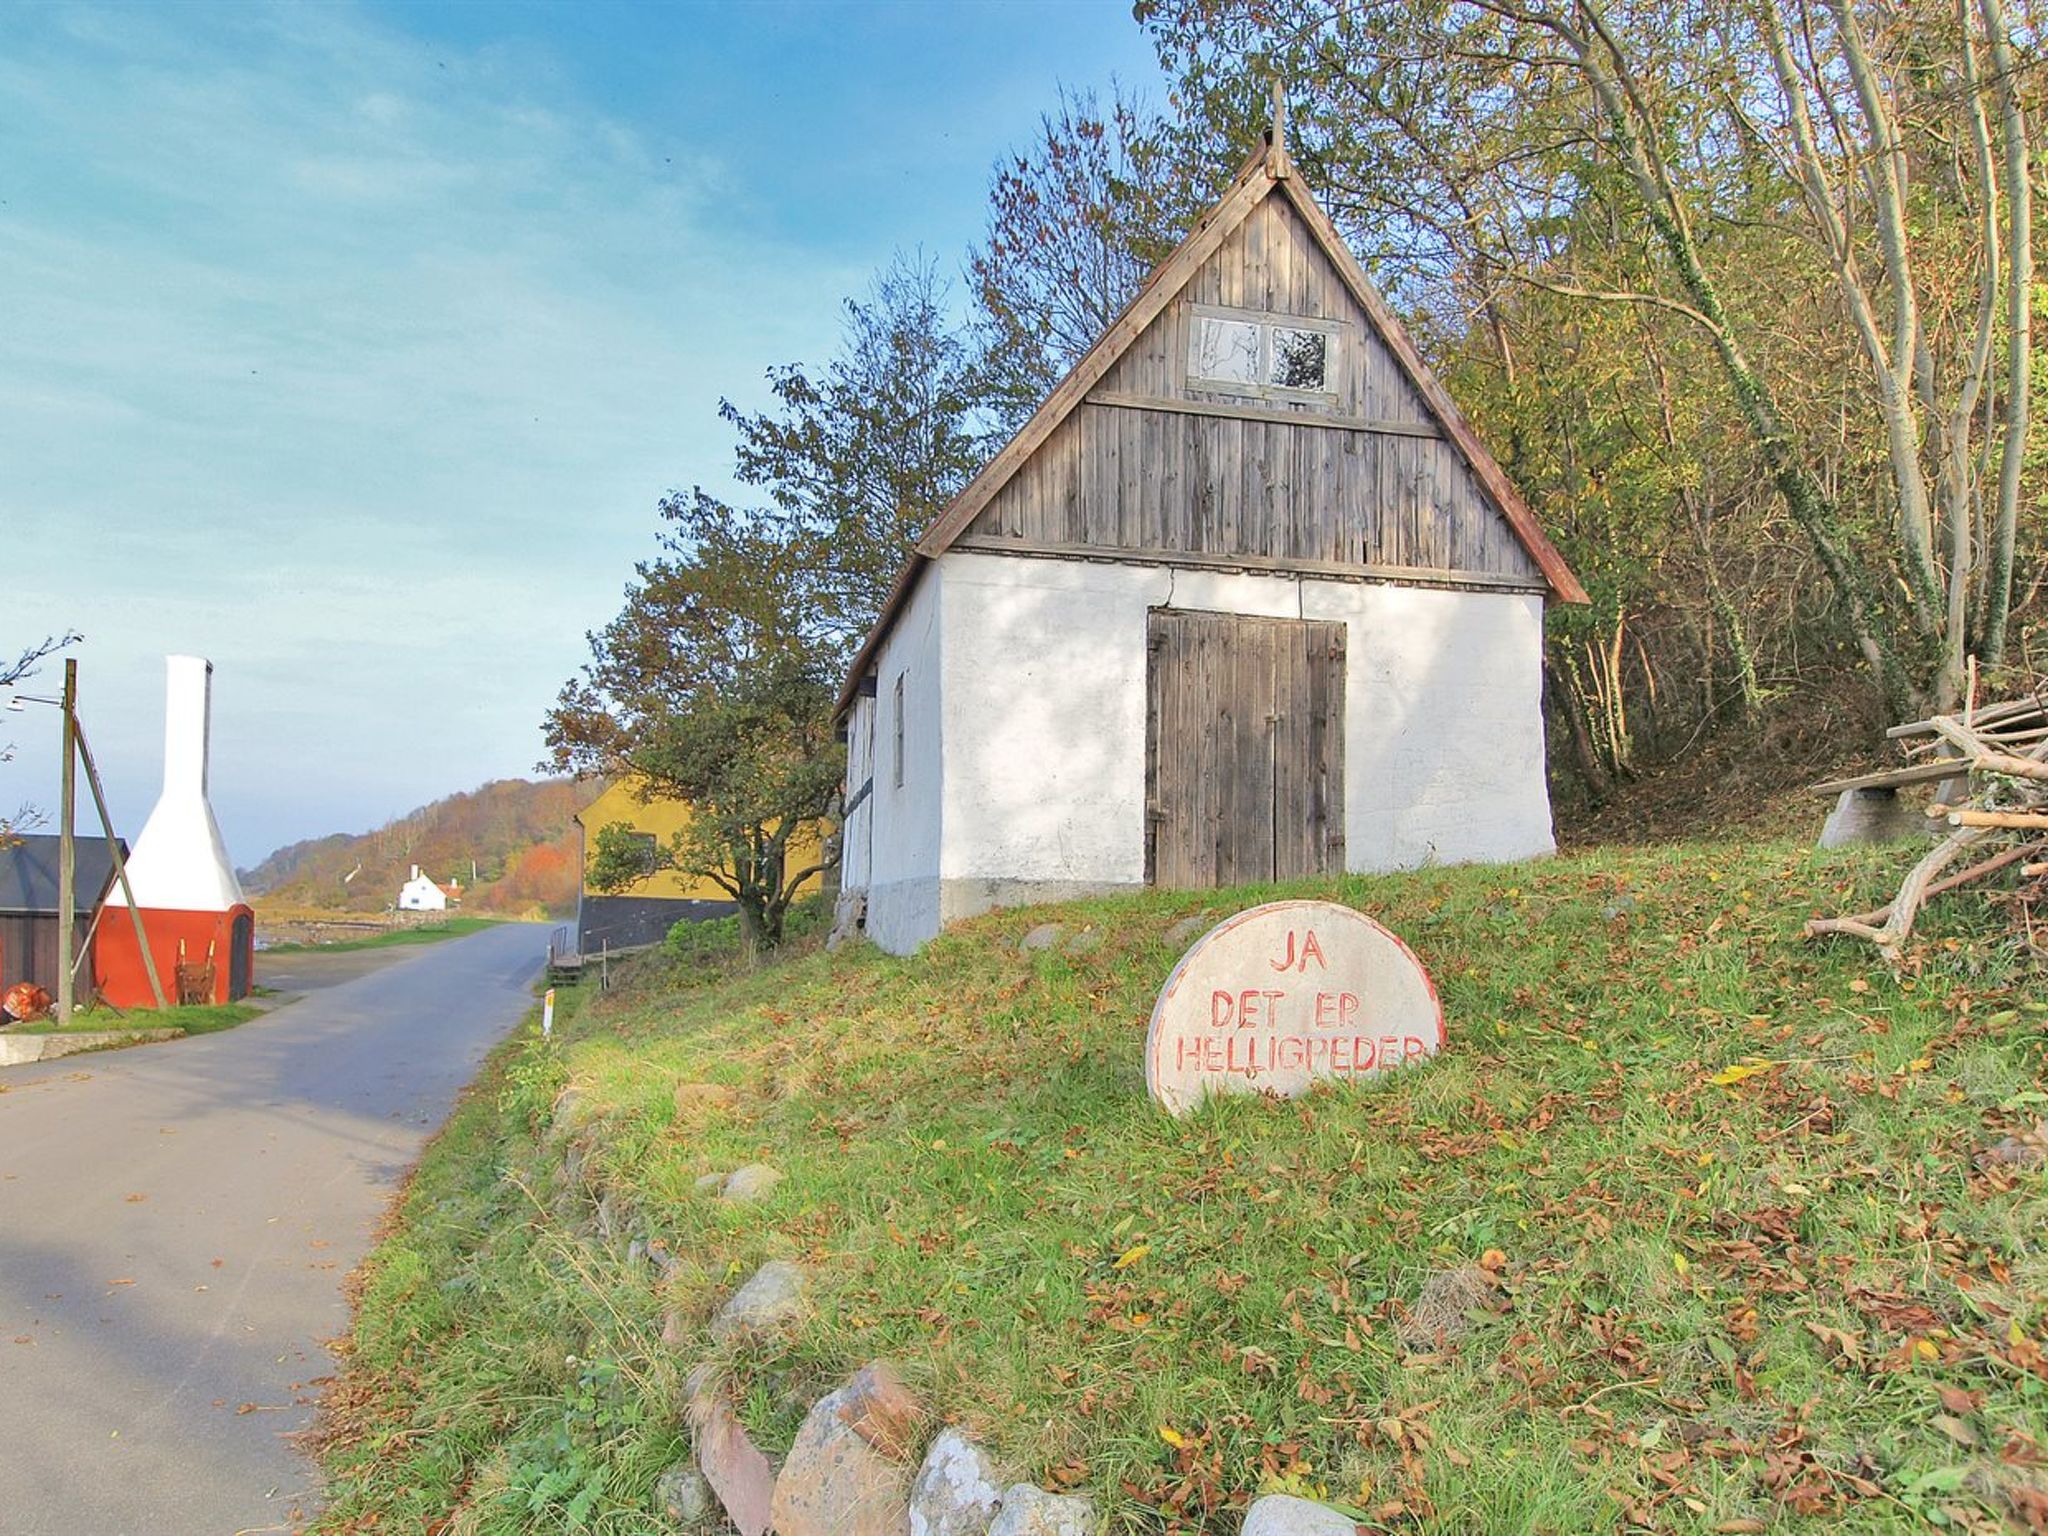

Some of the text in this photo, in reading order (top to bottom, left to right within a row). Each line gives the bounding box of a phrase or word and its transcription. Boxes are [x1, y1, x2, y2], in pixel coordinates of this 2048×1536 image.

[1270, 930, 1327, 973] JA
[1211, 990, 1360, 1028] DET ER
[1176, 1035, 1425, 1072] HELLIGPEDER
